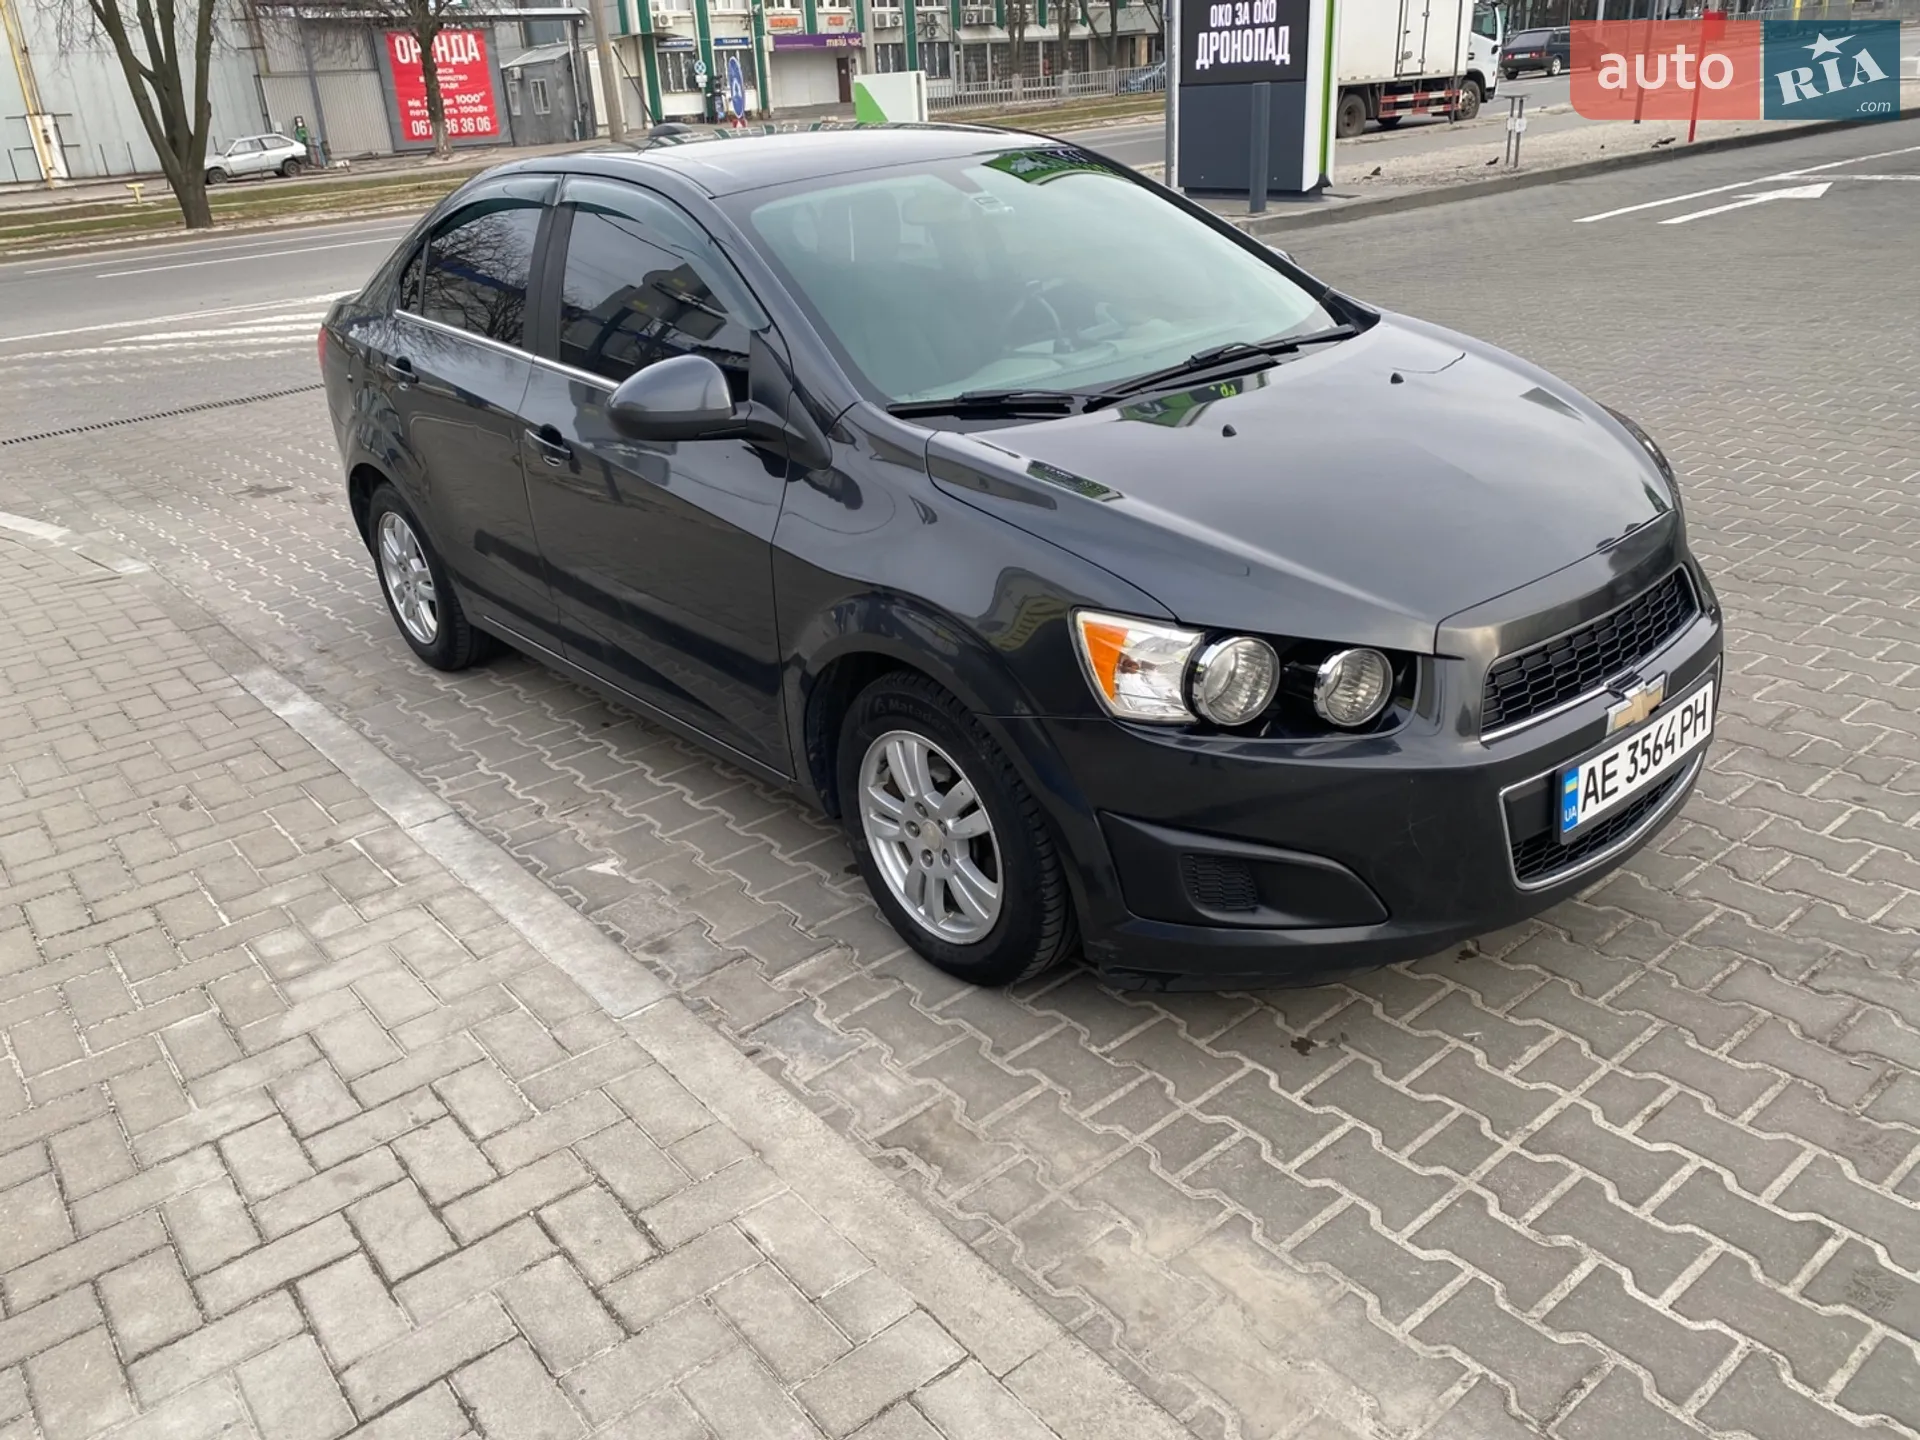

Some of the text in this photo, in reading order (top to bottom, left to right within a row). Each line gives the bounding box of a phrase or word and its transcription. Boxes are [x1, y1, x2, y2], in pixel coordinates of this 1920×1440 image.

[1210, 0, 1277, 28] ОКО ЗА ОКО
[394, 33, 481, 64] ОРНДА
[1195, 25, 1290, 70] ДРОНОПАД
[460, 117, 475, 133] 36
[476, 116, 491, 132] 06
[1581, 692, 1709, 813] AE 3564 PH
[1564, 806, 1578, 823] UA
